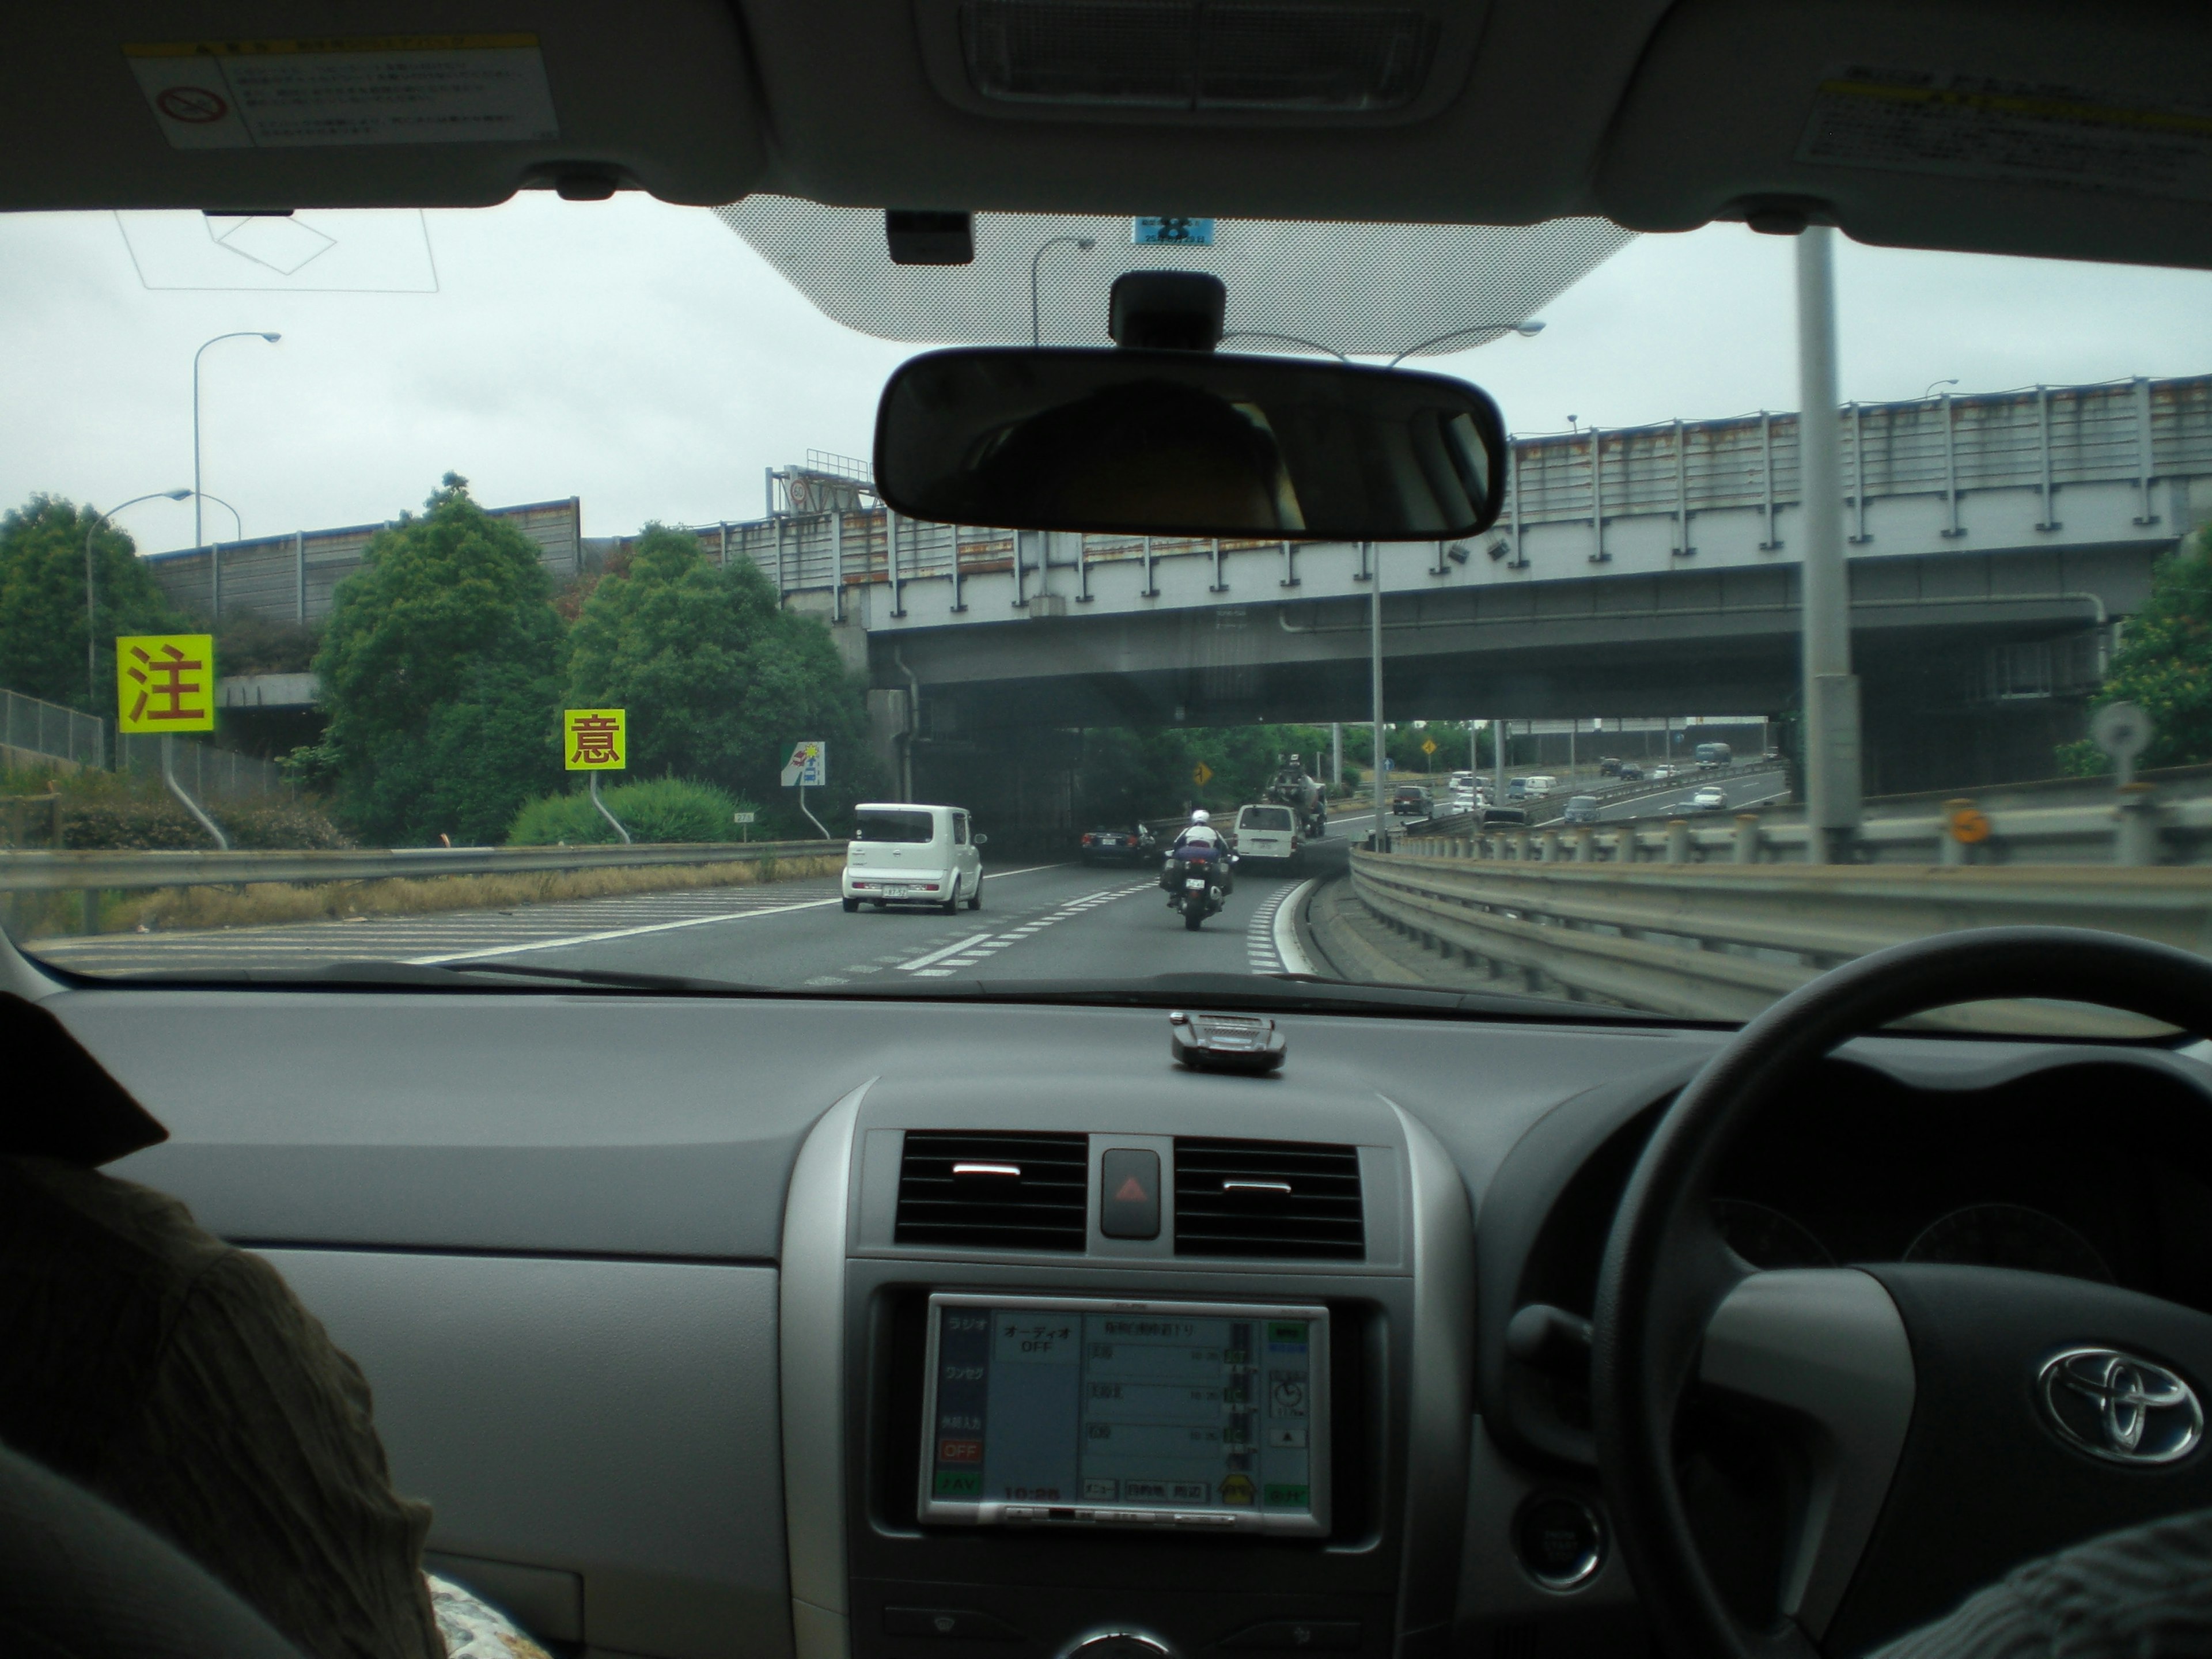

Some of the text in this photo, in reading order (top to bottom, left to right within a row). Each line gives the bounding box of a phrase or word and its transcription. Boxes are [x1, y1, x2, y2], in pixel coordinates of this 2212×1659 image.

[127, 643, 205, 723] 注
[571, 714, 620, 763] 意
[948, 1317, 988, 1331] ラジオ
[1004, 1325, 1072, 1340] オーディオ
[1021, 1340, 1052, 1353] OFF
[944, 1444, 977, 1458] OFF
